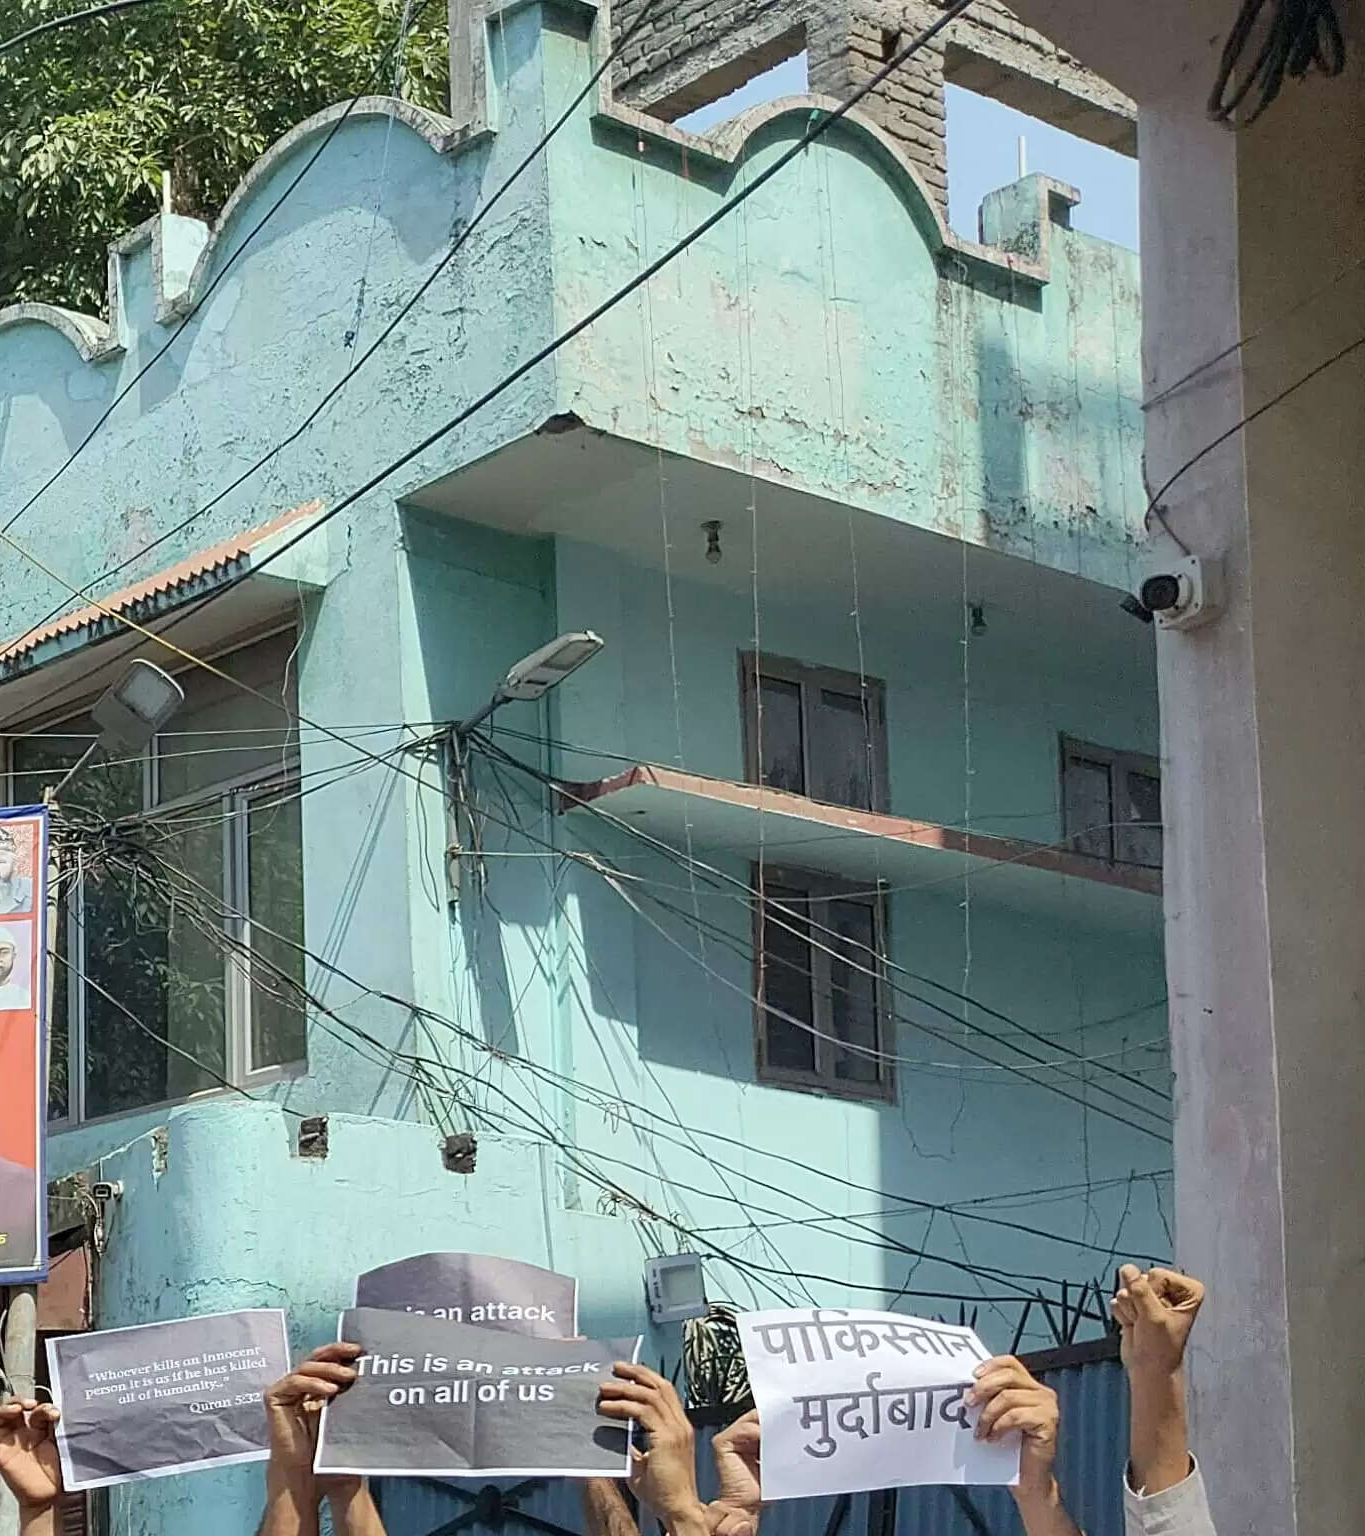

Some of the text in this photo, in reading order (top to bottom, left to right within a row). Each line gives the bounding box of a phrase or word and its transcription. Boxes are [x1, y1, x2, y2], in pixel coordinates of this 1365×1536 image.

[470, 1302, 555, 1324] attack
[752, 1309, 984, 1364] पाकिस्तान
[153, 1359, 180, 1373] kills
[183, 1356, 200, 1367] an
[202, 1347, 261, 1363] innocent
[355, 1352, 601, 1377] This is an attack
[84, 1358, 267, 1400] person it is as if he has killed
[118, 1392, 135, 1405] all
[138, 1390, 152, 1402] of
[189, 1392, 261, 1414] Quran 5:32
[388, 1379, 555, 1406] on all of us
[792, 1371, 975, 1458] मुर्दाबाद
